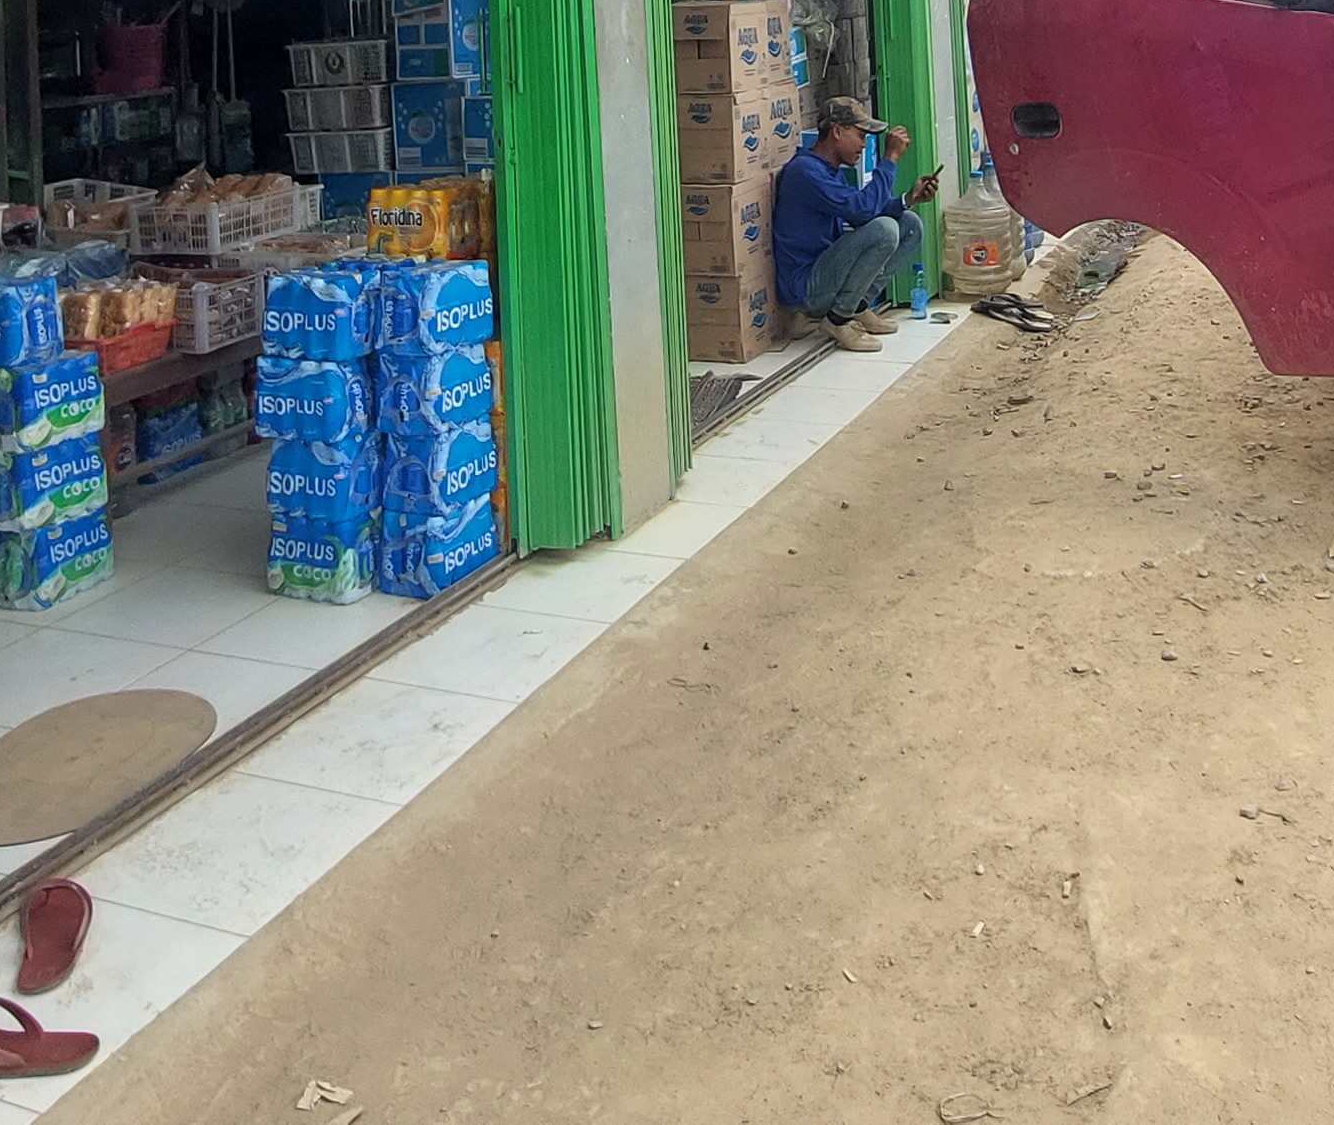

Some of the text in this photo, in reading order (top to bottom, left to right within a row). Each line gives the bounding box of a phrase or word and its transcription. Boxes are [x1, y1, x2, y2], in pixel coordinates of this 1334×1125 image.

[737, 27, 759, 47] AQUA
[767, 16, 783, 38] QUA
[769, 97, 793, 121] AQUA
[741, 114, 761, 134] AQUA
[685, 194, 710, 205] AQUA
[370, 208, 423, 227] Floridina
[740, 201, 761, 225] AQUA
[695, 282, 721, 293] AQUA
[748, 288, 768, 313] AQUA
[263, 310, 336, 333] ISOPLUS
[436, 298, 493, 333] ISOPLUS
[34, 375, 98, 409] ISOPLUS
[442, 372, 492, 414] ISOPLUS
[60, 398, 97, 419] COCO
[258, 396, 325, 417] ISOPLUS
[34, 453, 103, 491] ISOPLUS
[446, 448, 497, 495] ISOPLUS
[62, 477, 101, 509] COCO
[49, 523, 109, 564] ISOPLUS
[270, 536, 335, 561] ISOPLUS
[444, 530, 492, 575] ISOPLUS
[74, 547, 109, 571] COCO
[292, 564, 332, 581] COCO
